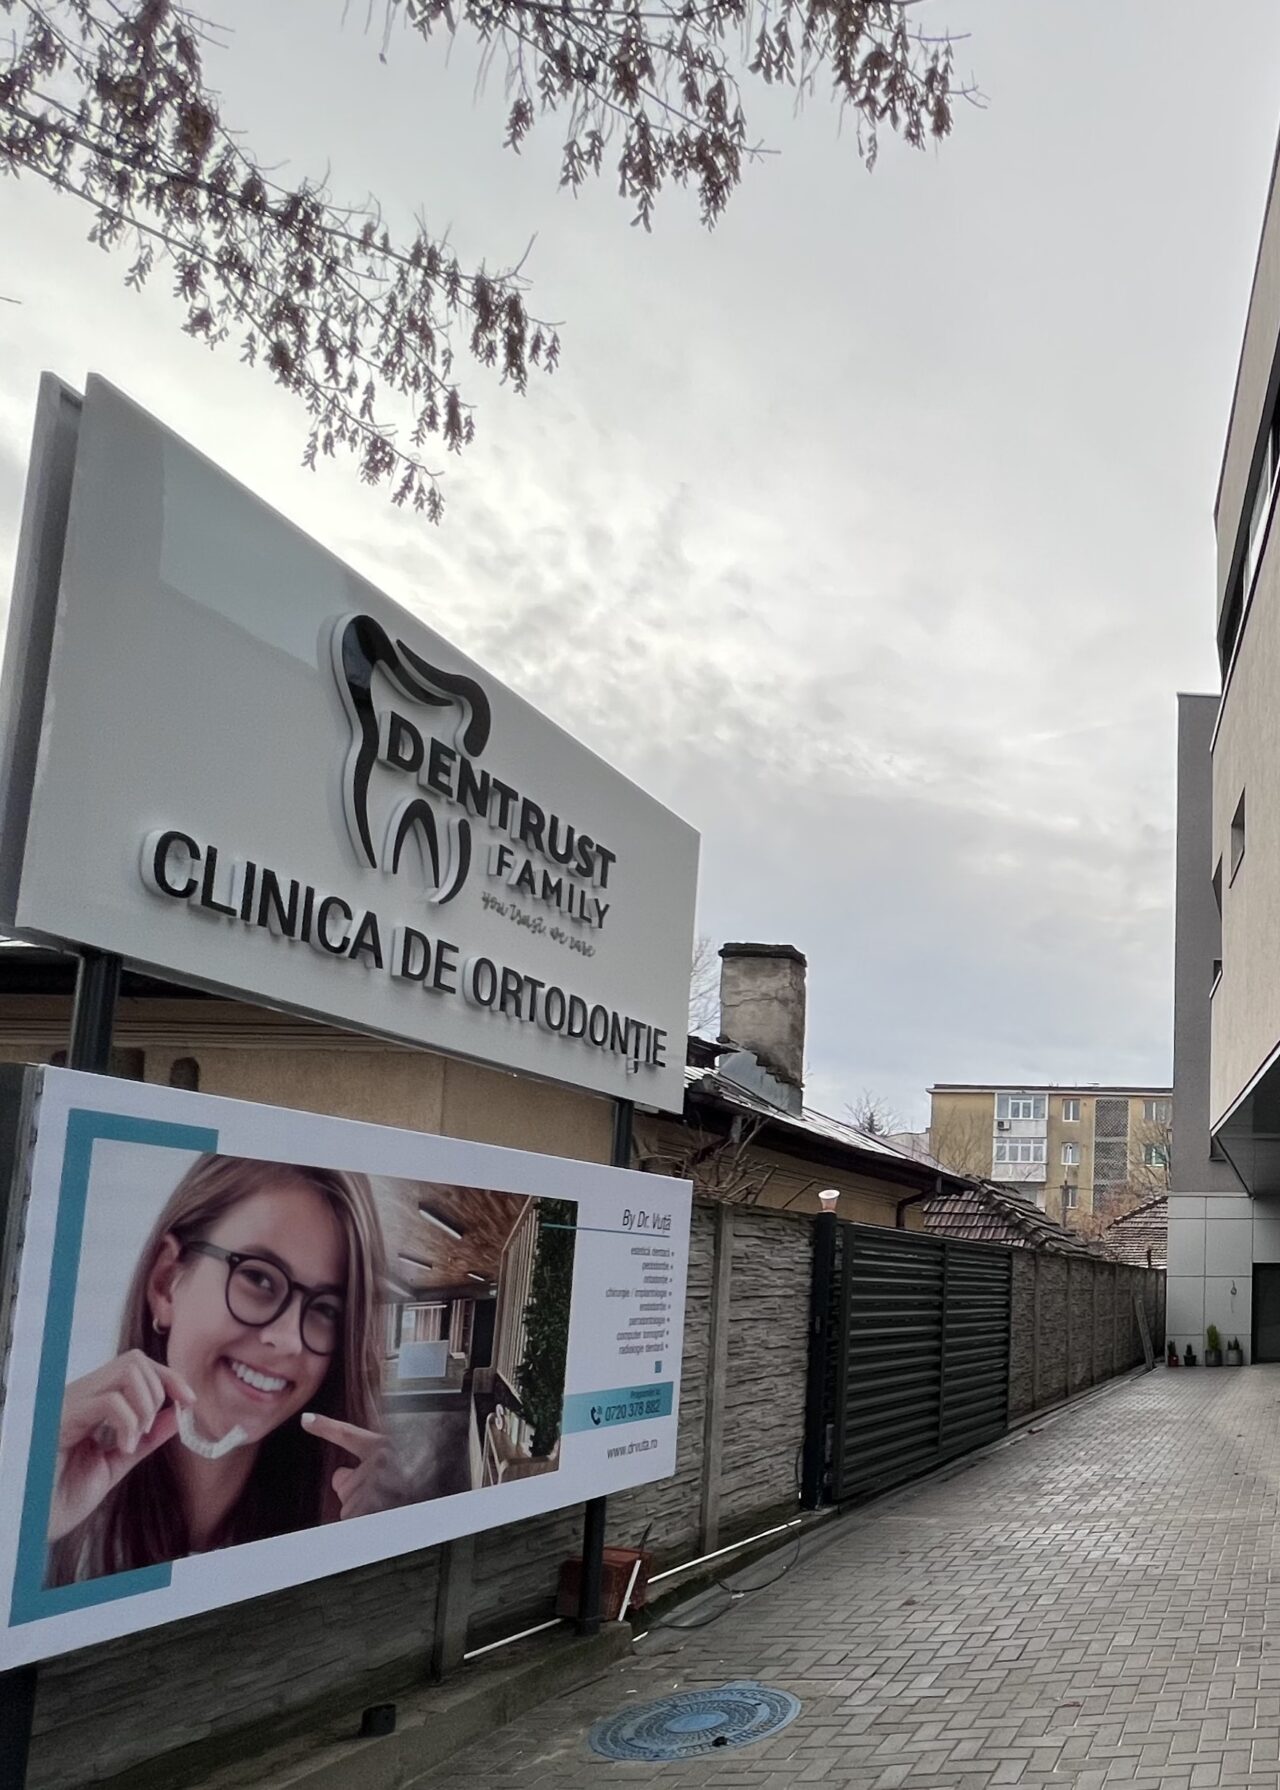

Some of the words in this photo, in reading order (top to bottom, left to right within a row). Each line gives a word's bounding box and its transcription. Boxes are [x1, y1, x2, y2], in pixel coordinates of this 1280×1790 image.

[382, 711, 616, 890] DENTRUST
[494, 845, 611, 929] FAMILY
[150, 830, 384, 970] CLINICA
[400, 926, 460, 994] DE
[471, 957, 668, 1074] ORTODONȚIE
[622, 1209, 636, 1230] By
[637, 1210, 650, 1229] Dr.
[605, 1403, 627, 1421] 0720
